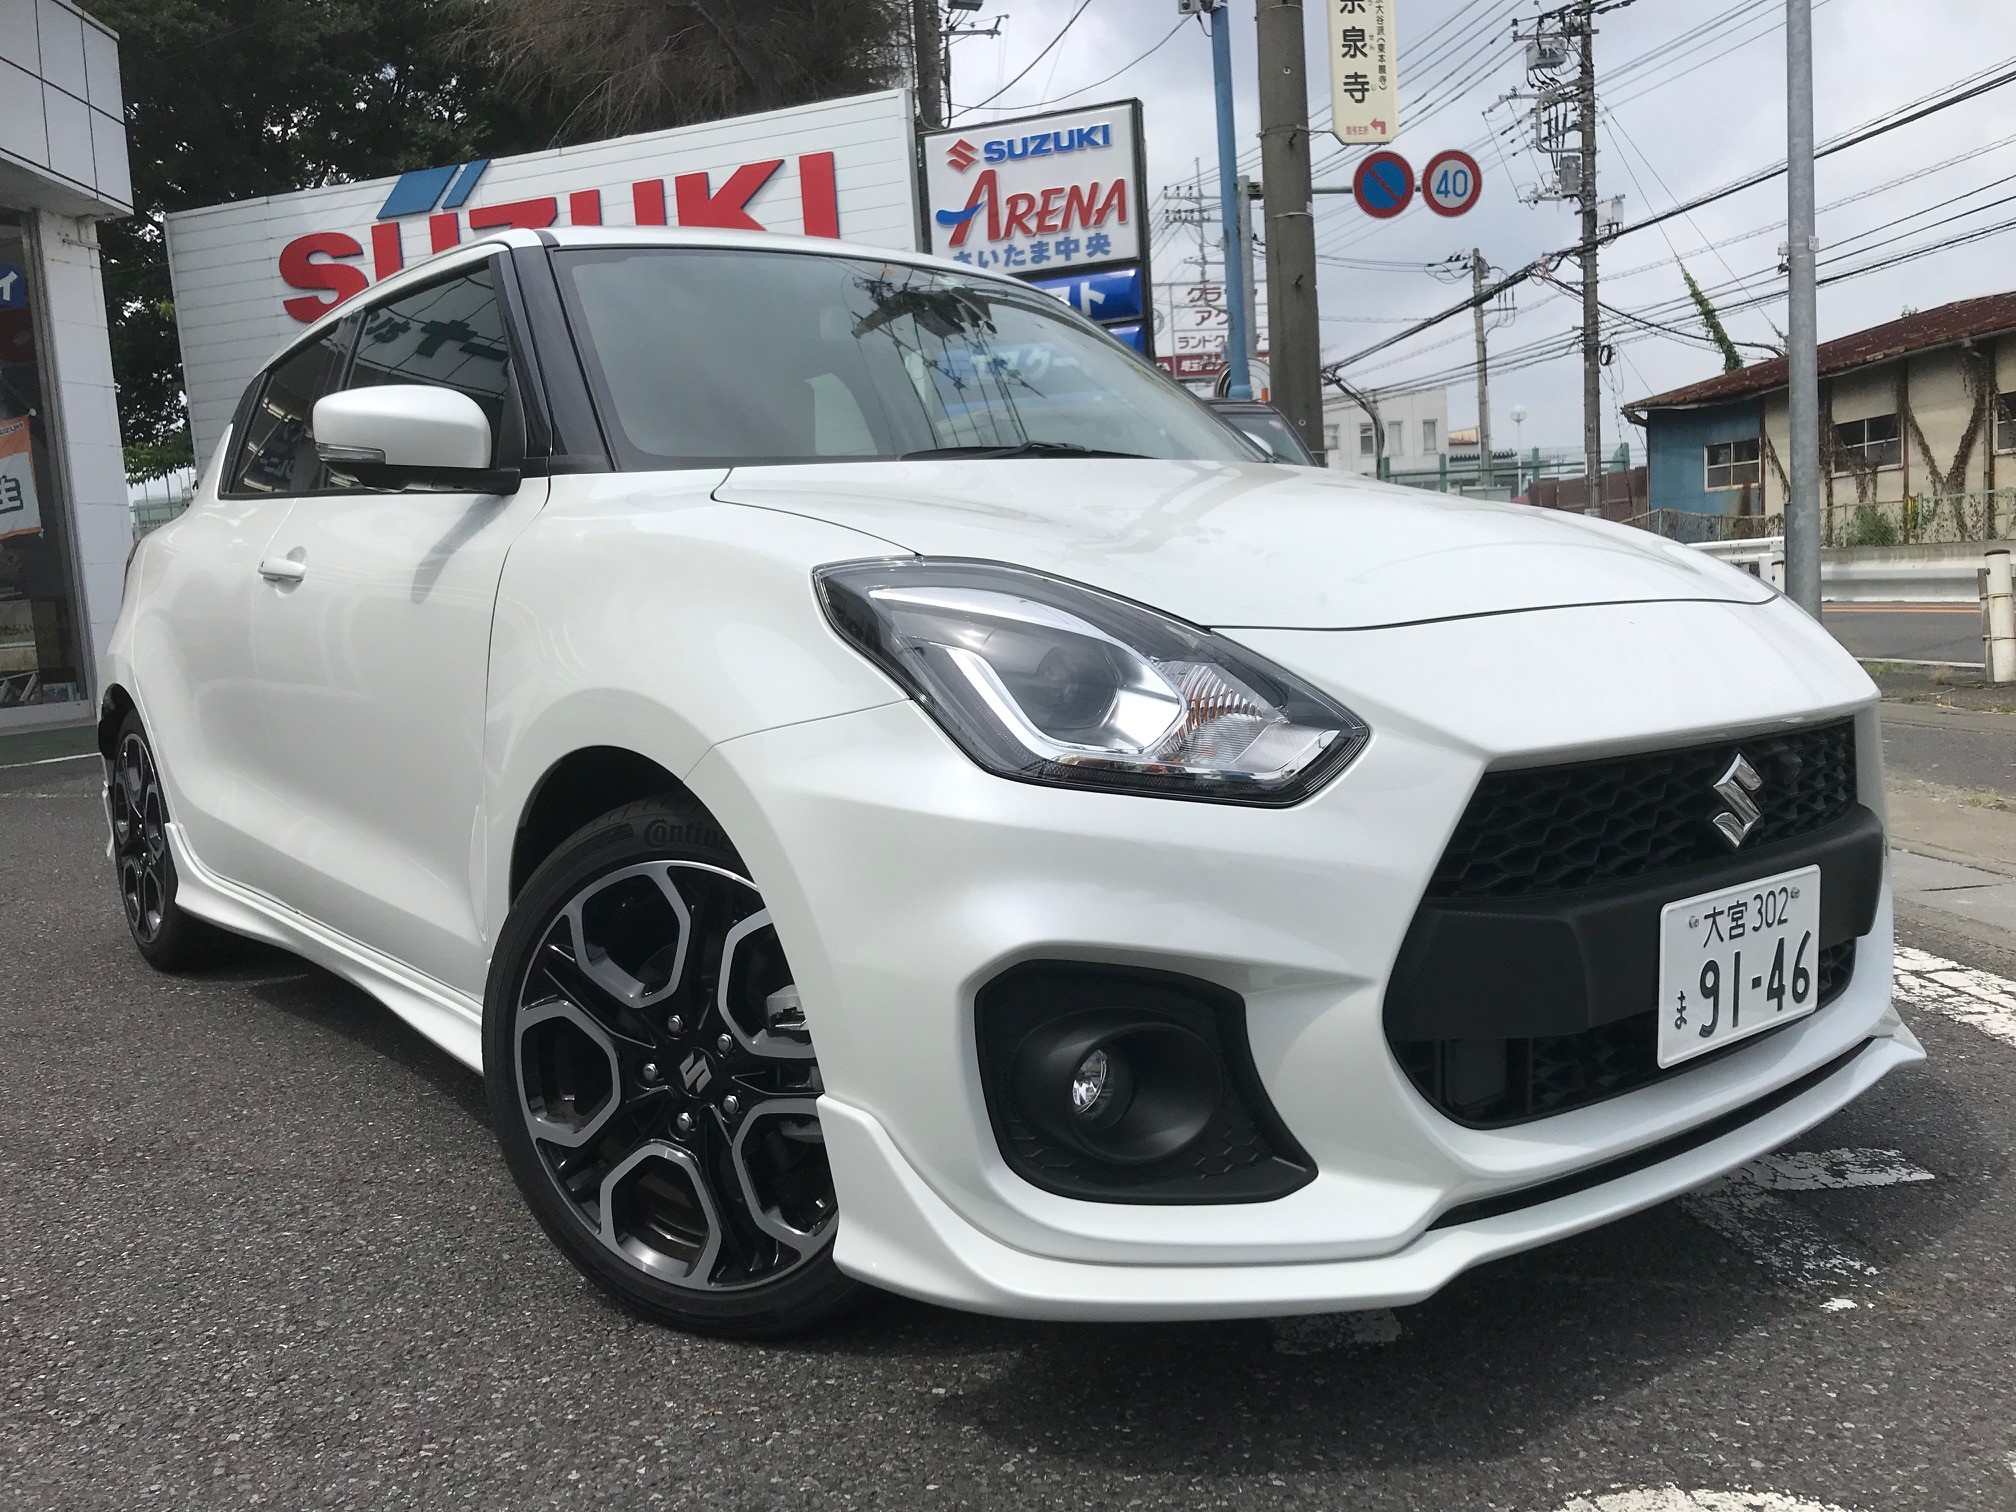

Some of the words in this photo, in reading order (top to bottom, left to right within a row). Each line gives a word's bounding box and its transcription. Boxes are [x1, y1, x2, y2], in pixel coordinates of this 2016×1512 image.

[984, 123, 1111, 164] SUZUKI
[936, 169, 1128, 247] ARENA
[1436, 170, 1468, 198] 40
[953, 232, 1112, 268] さいたま中央
[1704, 900, 1748, 948] 大宮
[1752, 887, 1789, 932] 302
[1674, 990, 1687, 1030] ま
[1699, 930, 1812, 1038] 91-46
